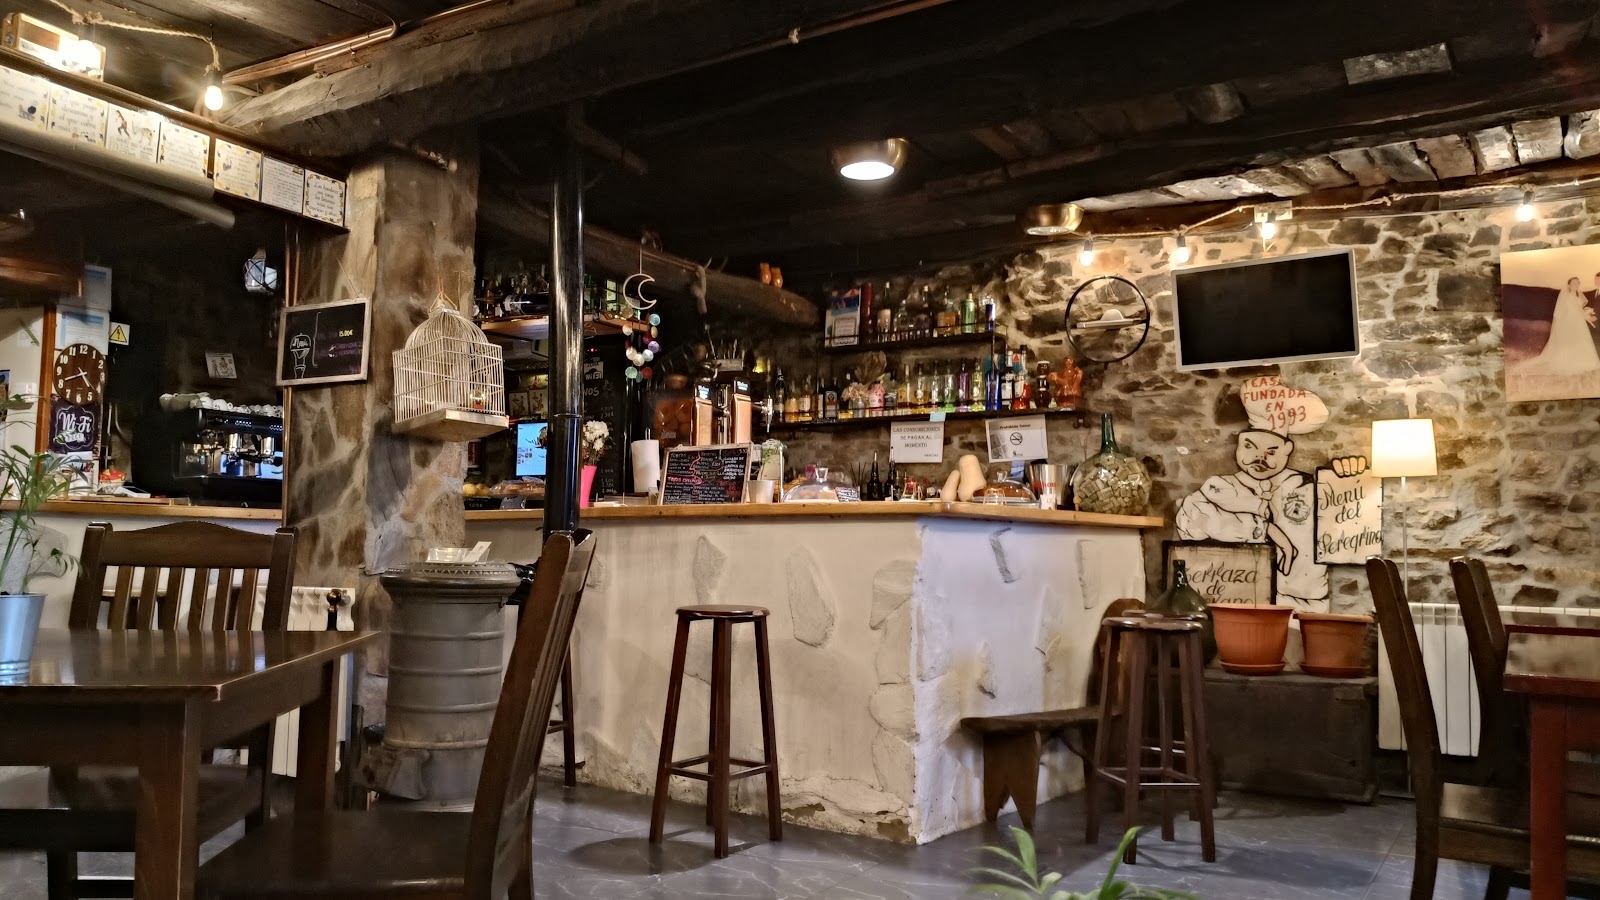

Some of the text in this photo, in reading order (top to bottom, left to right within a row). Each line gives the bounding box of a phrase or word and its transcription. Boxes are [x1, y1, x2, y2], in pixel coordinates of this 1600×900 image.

[69, 346, 76, 356] 11
[80, 345, 88, 354] 12
[92, 350, 96, 359] 1
[60, 354, 68, 364] 10
[98, 360, 104, 369] 2
[56, 366, 62, 375] 9
[100, 372, 105, 382] 3
[1250, 376, 1284, 388] CASA
[58, 379, 64, 389] 8
[96, 383, 101, 393] 4
[66, 389, 71, 399] 7
[76, 394, 81, 403] 6
[87, 392, 93, 401] 5
[1243, 387, 1307, 404] FUNDADA
[1265, 401, 1284, 412] EN
[58, 412, 92, 433] Wi-Fi
[1268, 405, 1307, 430] 1993
[1320, 479, 1365, 511] Menú
[1335, 501, 1362, 524] del
[1318, 525, 1383, 555] Peregrino
[1206, 579, 1226, 595] de
